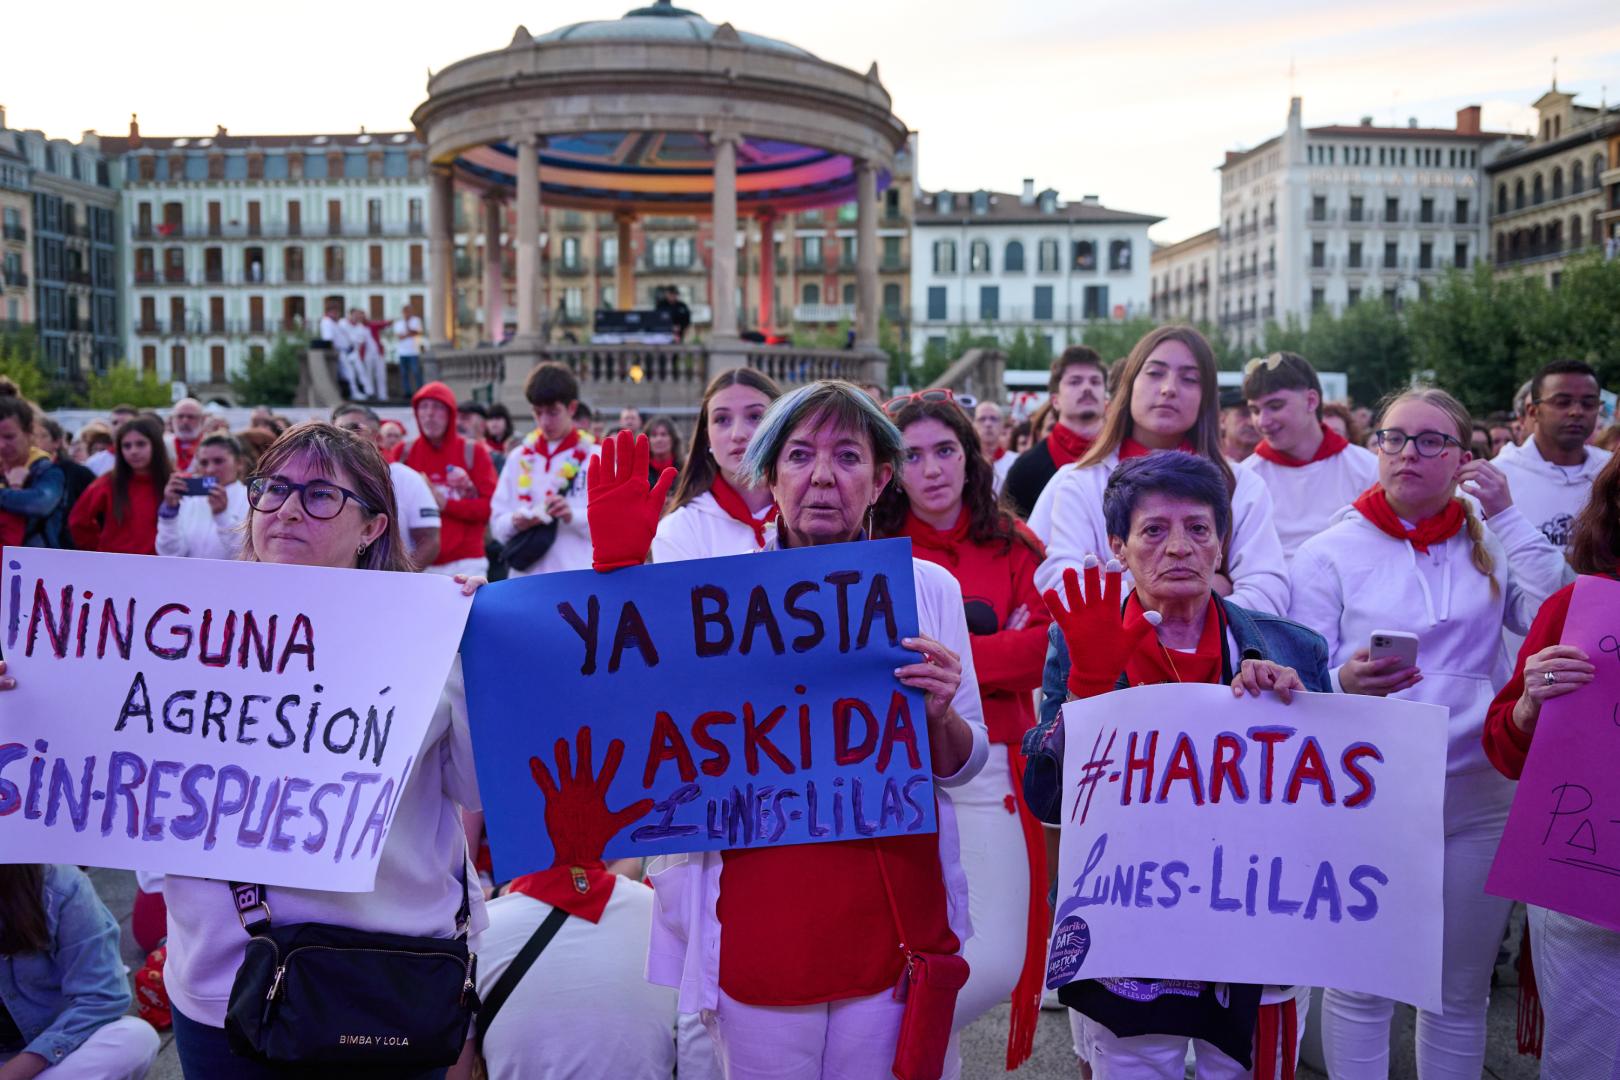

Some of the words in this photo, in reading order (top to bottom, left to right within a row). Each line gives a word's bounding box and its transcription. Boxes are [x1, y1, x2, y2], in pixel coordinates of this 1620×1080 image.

[557, 594, 660, 676] YA
[690, 570, 898, 657] BASTA
[832, 690, 923, 774] DA
[339, 1035, 372, 1045] BIMBA
[375, 1036, 381, 1045] Y
[383, 1036, 409, 1046] LOLA
